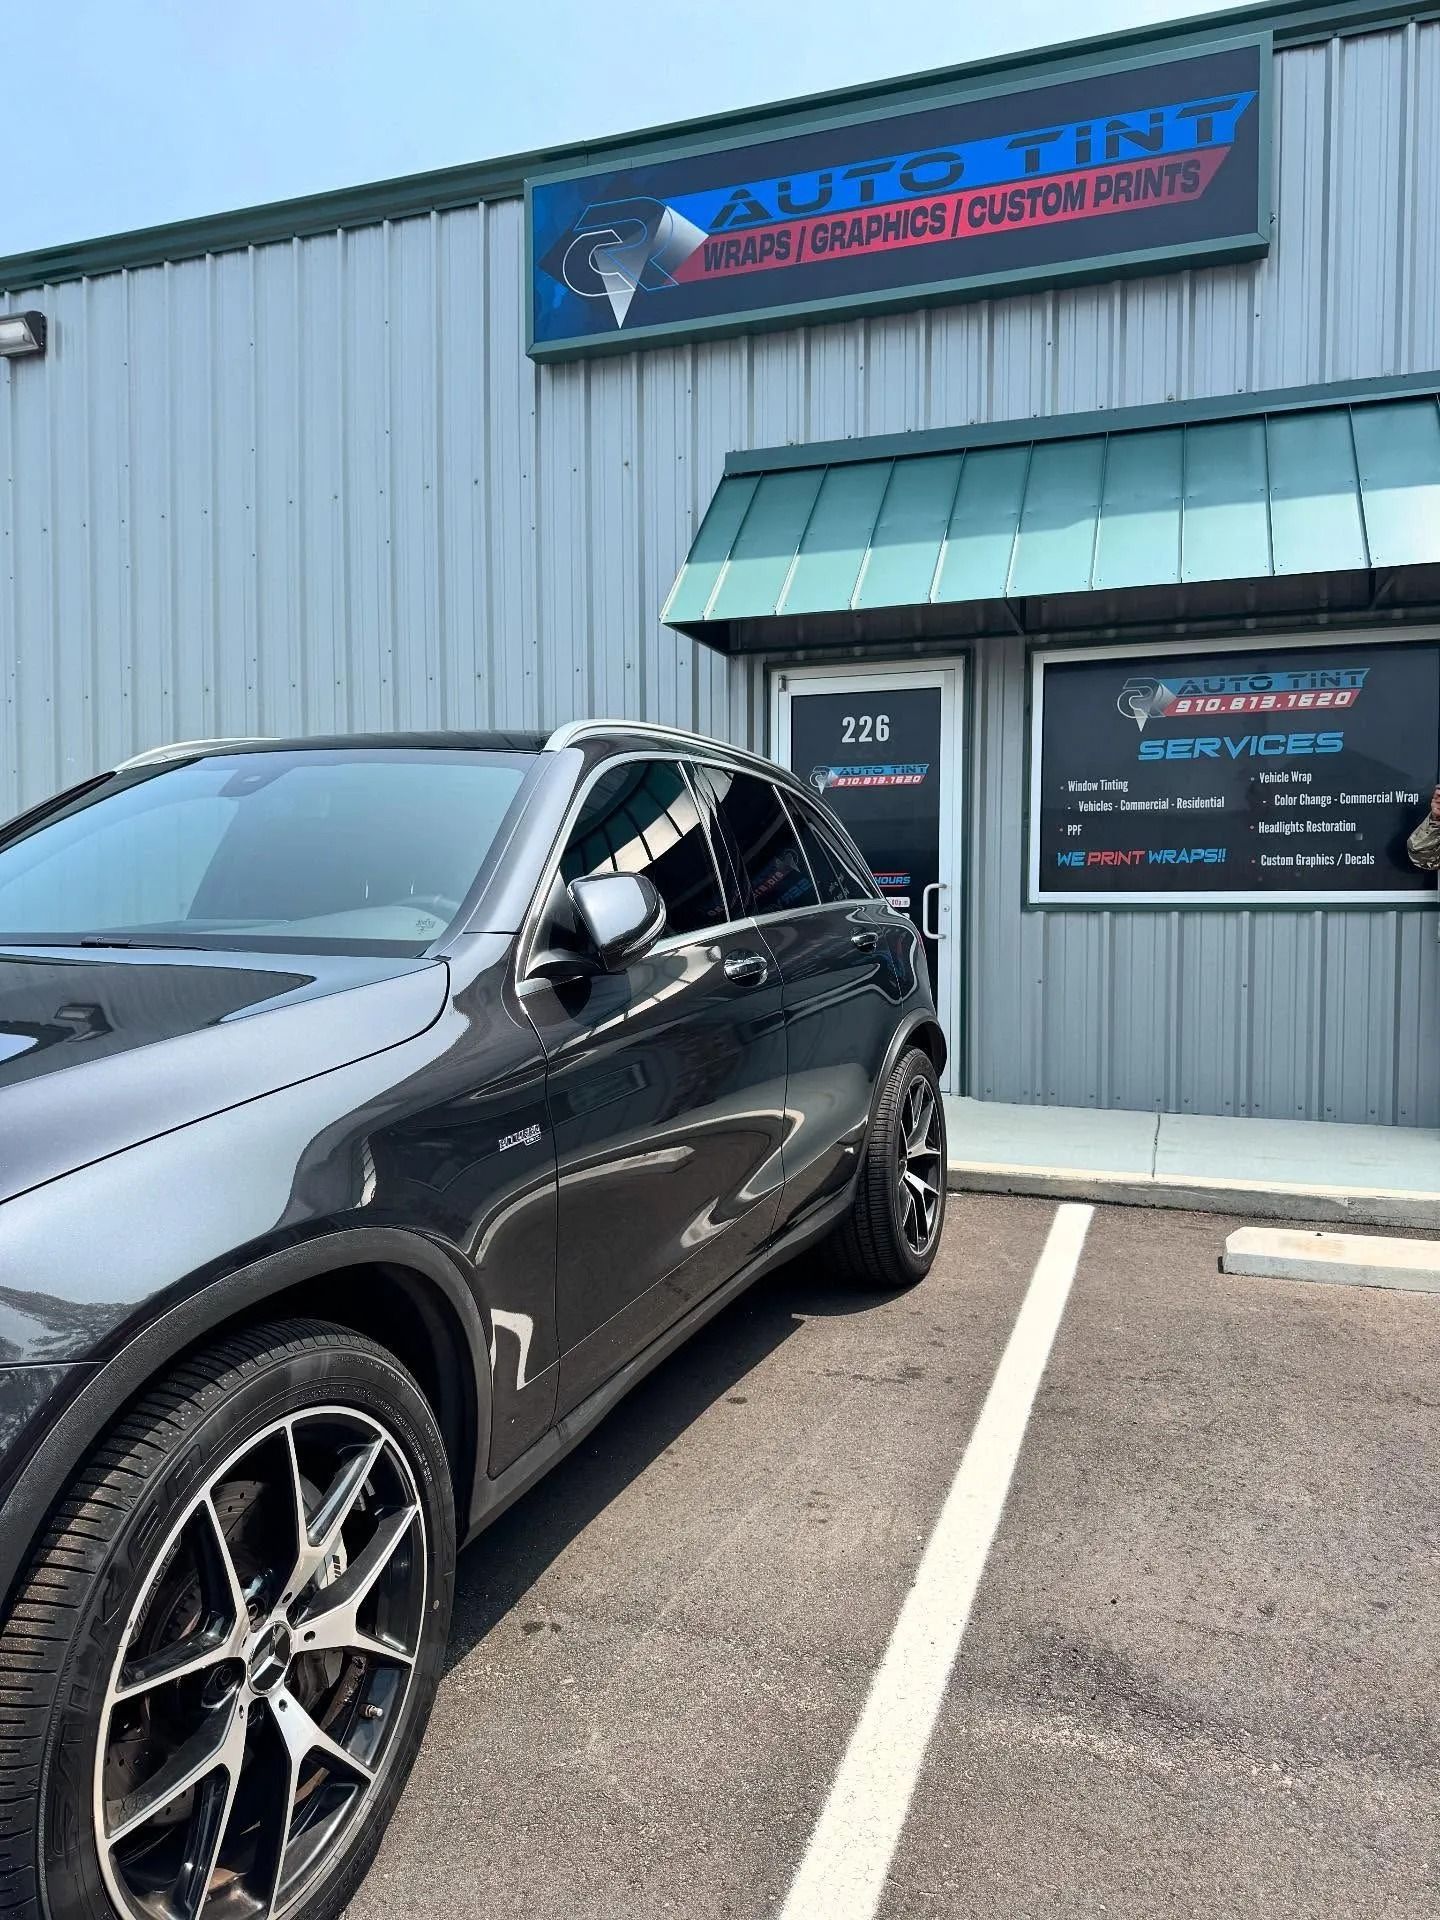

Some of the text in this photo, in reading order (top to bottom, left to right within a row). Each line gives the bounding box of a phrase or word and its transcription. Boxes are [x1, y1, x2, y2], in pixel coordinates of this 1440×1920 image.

[710, 151, 965, 228] AUTO
[704, 229, 792, 272] WRAPS
[810, 203, 947, 254] GRAPHICS
[967, 173, 1088, 229] CUSTOM
[1092, 159, 1200, 208] PRINTS
[1177, 675, 1273, 696] AUTO
[1175, 691, 1352, 713] 910.813.1620
[841, 714, 890, 743] 226
[1138, 731, 1345, 761] SERVICES
[839, 766, 885, 776] AUTO
[1259, 771, 1312, 785] Vehicle Wrap
[1067, 779, 1129, 793] Window Tinting
[1078, 800, 1113, 813] Vehicles
[1120, 797, 1169, 811] Commercial
[1176, 796, 1225, 809] Residential
[1274, 794, 1298, 806] Color
[1299, 793, 1332, 808] Change
[1339, 791, 1393, 805] Commercial
[1395, 790, 1419, 805] Wrap
[1067, 824, 1083, 836] PPF
[1258, 819, 1356, 836] Headlights Restoration
[1057, 847, 1227, 867] WE PRINT WRAPS!!
[1260, 854, 1294, 867] Custom
[1295, 853, 1335, 868] Graphics
[1344, 852, 1375, 865] Decals
